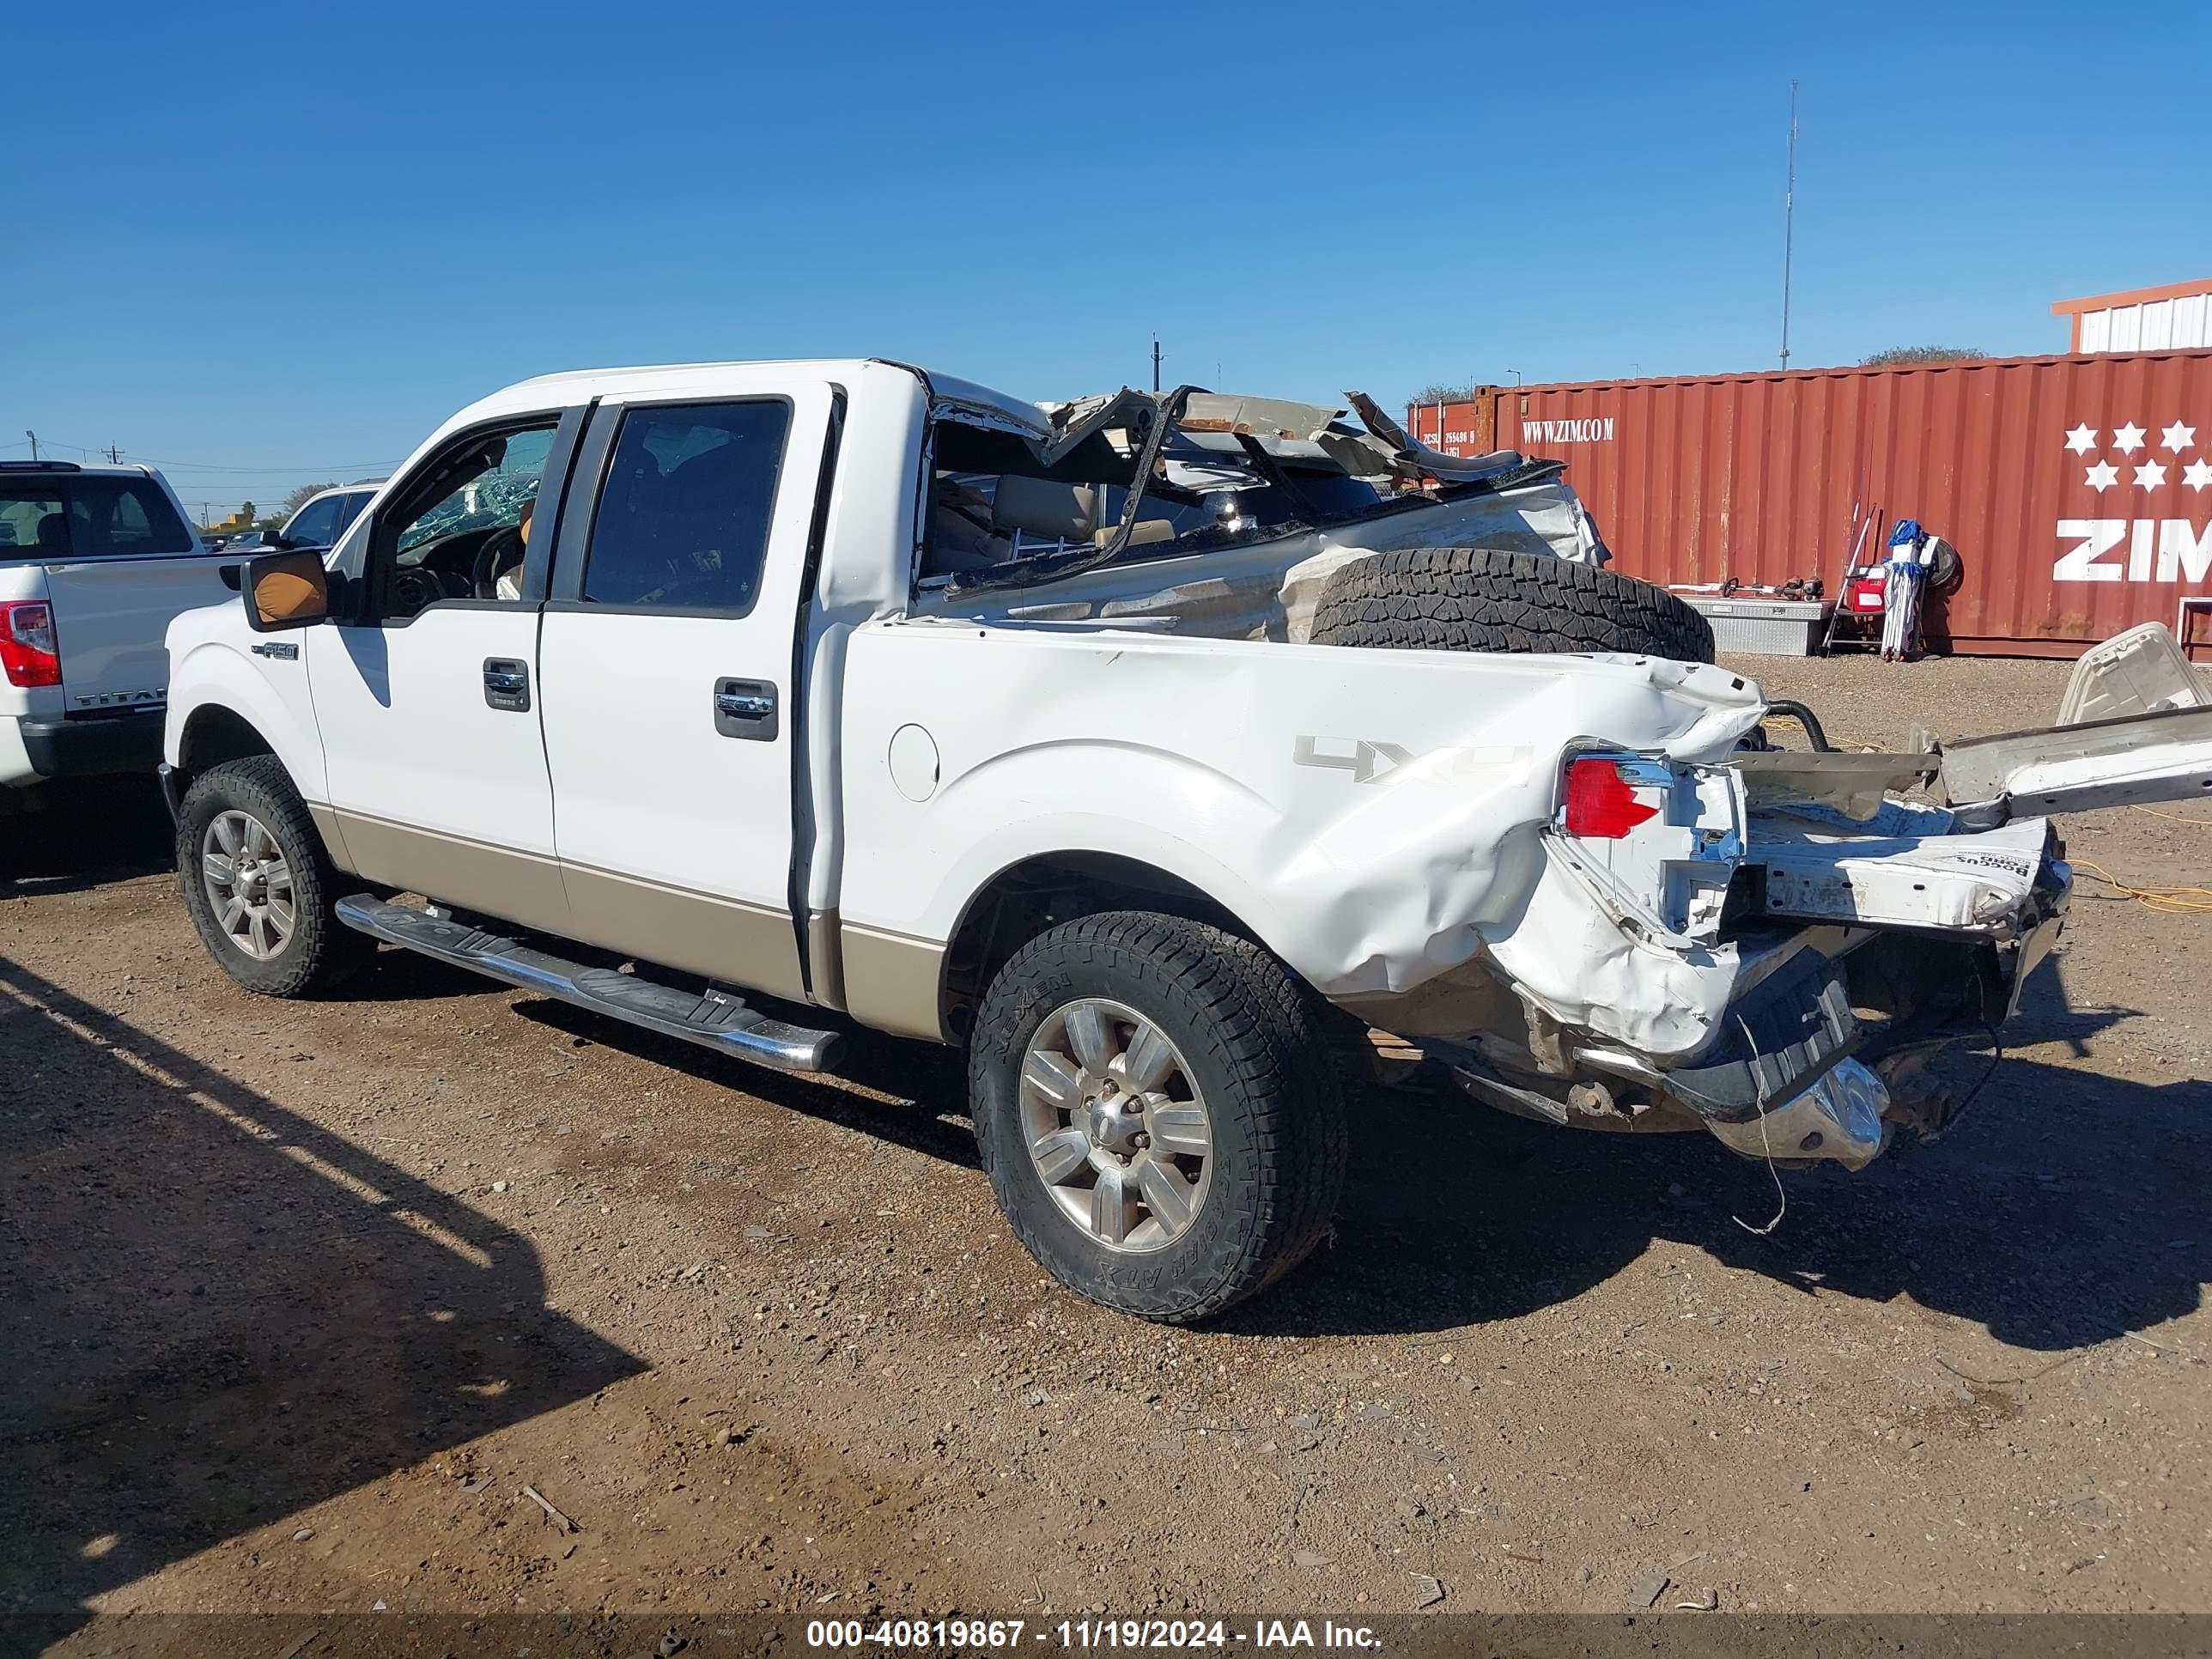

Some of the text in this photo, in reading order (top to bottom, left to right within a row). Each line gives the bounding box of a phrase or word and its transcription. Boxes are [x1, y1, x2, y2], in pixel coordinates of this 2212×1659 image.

[1445, 431, 1468, 444] 255496
[1522, 417, 1614, 445] WWW.ZIM.COM
[2052, 518, 2212, 583] ZIM
[1957, 856, 2028, 877] BOGGUS
[1980, 856, 2030, 869] FORD
[994, 970, 1073, 1057] NEXEN
[1098, 1261, 1164, 1292] ATX
